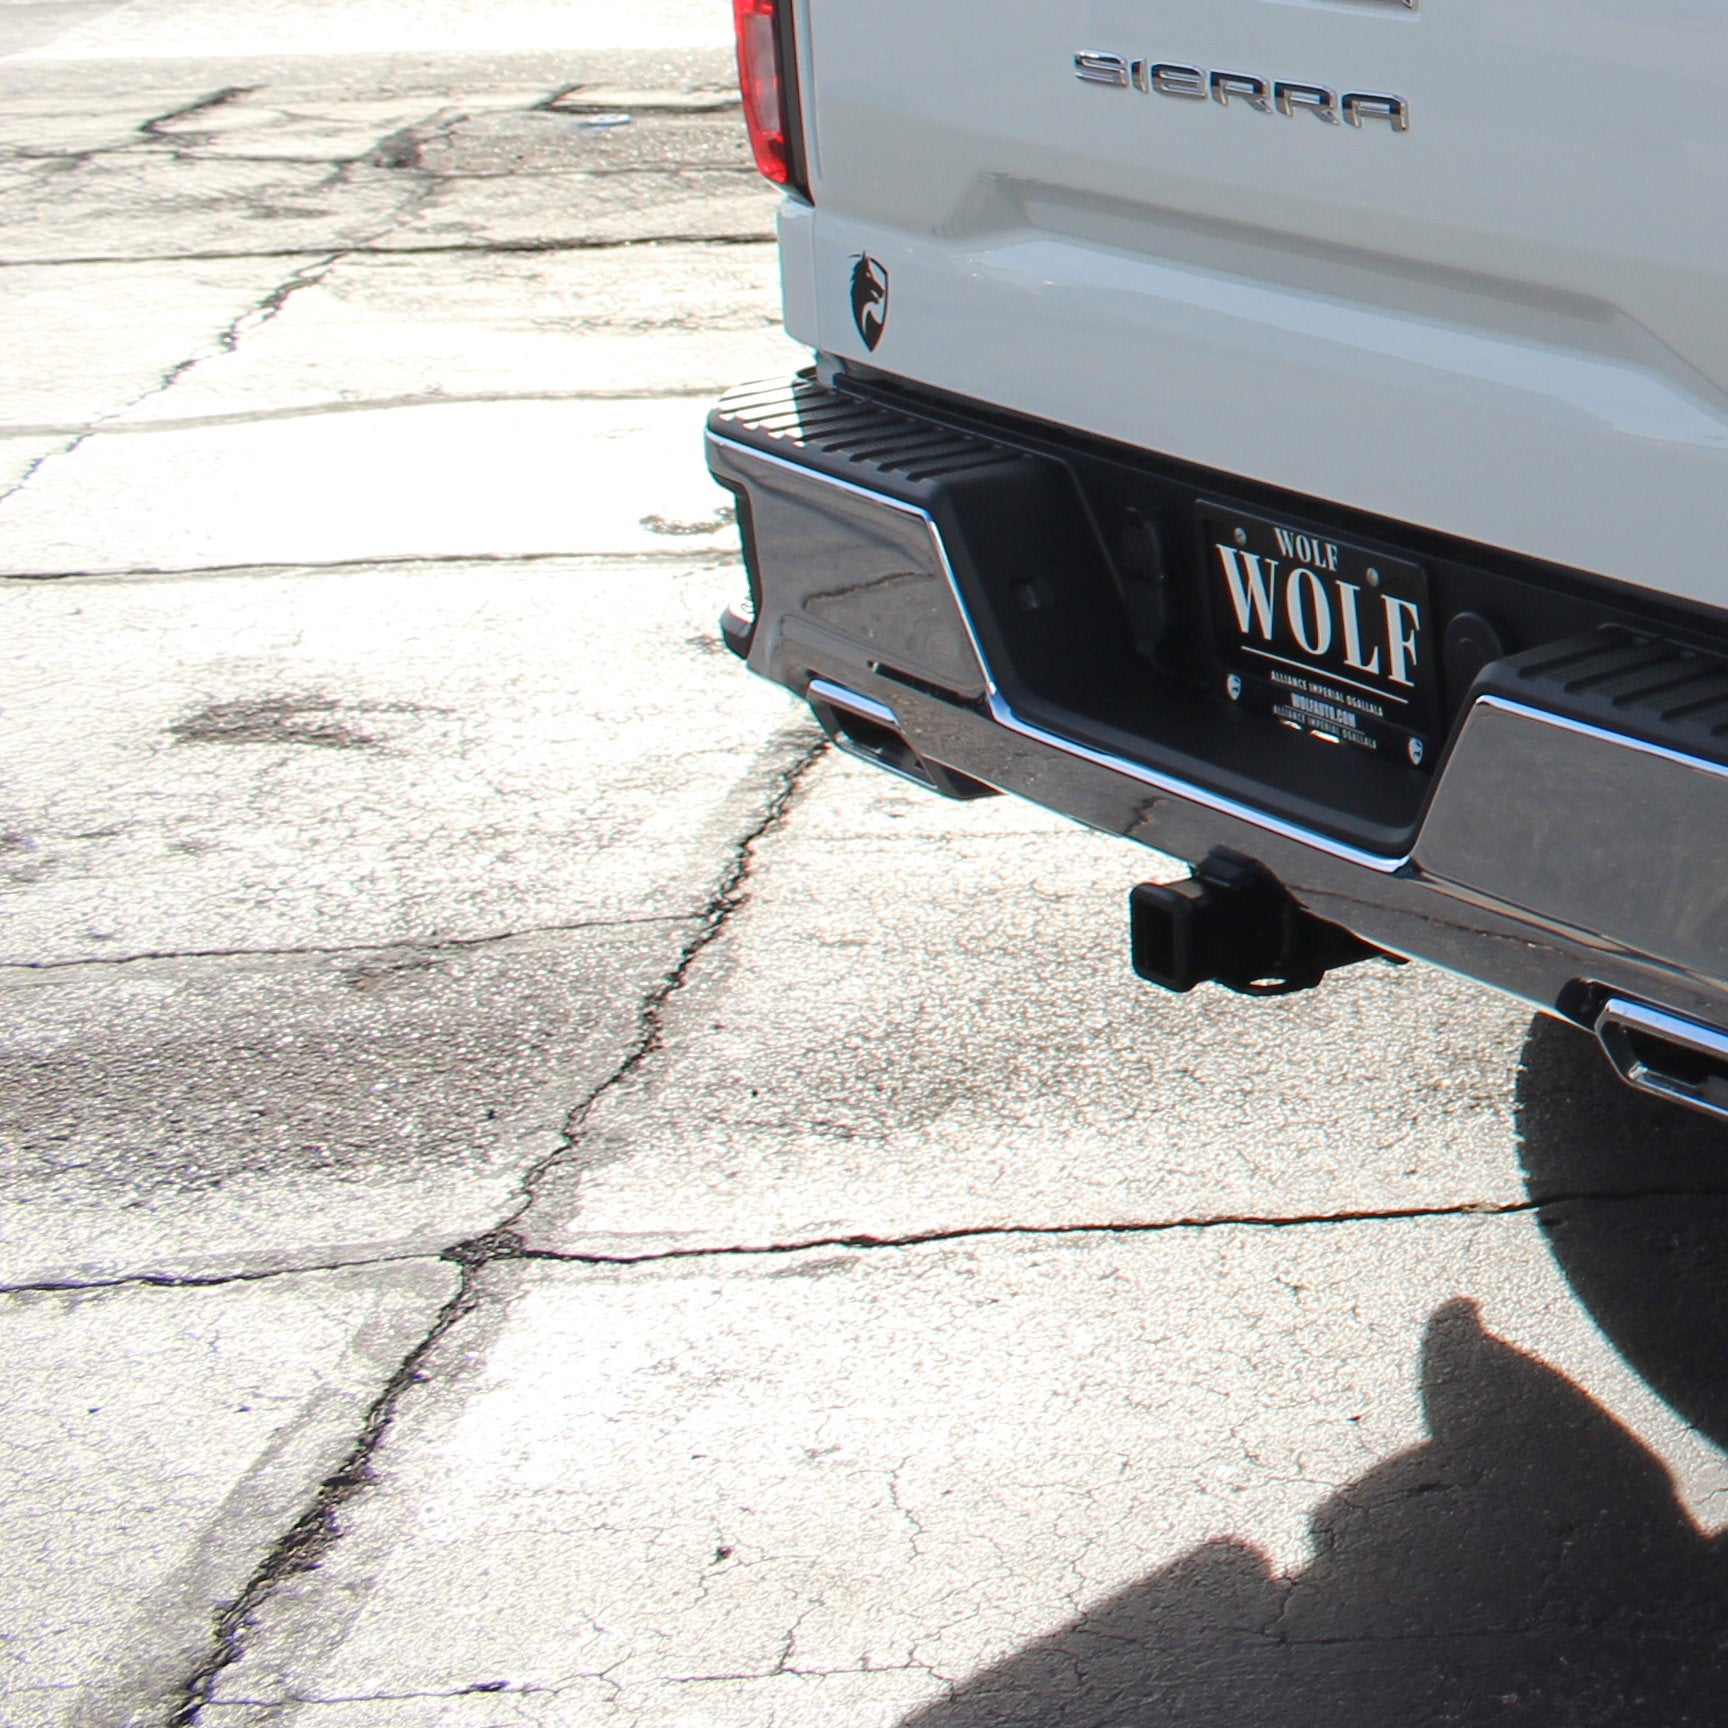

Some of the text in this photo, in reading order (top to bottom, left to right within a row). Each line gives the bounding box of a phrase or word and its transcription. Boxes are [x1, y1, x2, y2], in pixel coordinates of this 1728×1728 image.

[1073, 48, 1410, 132] SIERRA
[1273, 526, 1339, 572] WOLF
[1214, 543, 1421, 688] WOLF
[1270, 670, 1384, 718] ALLIANCE IMPERIAL OGALLALA
